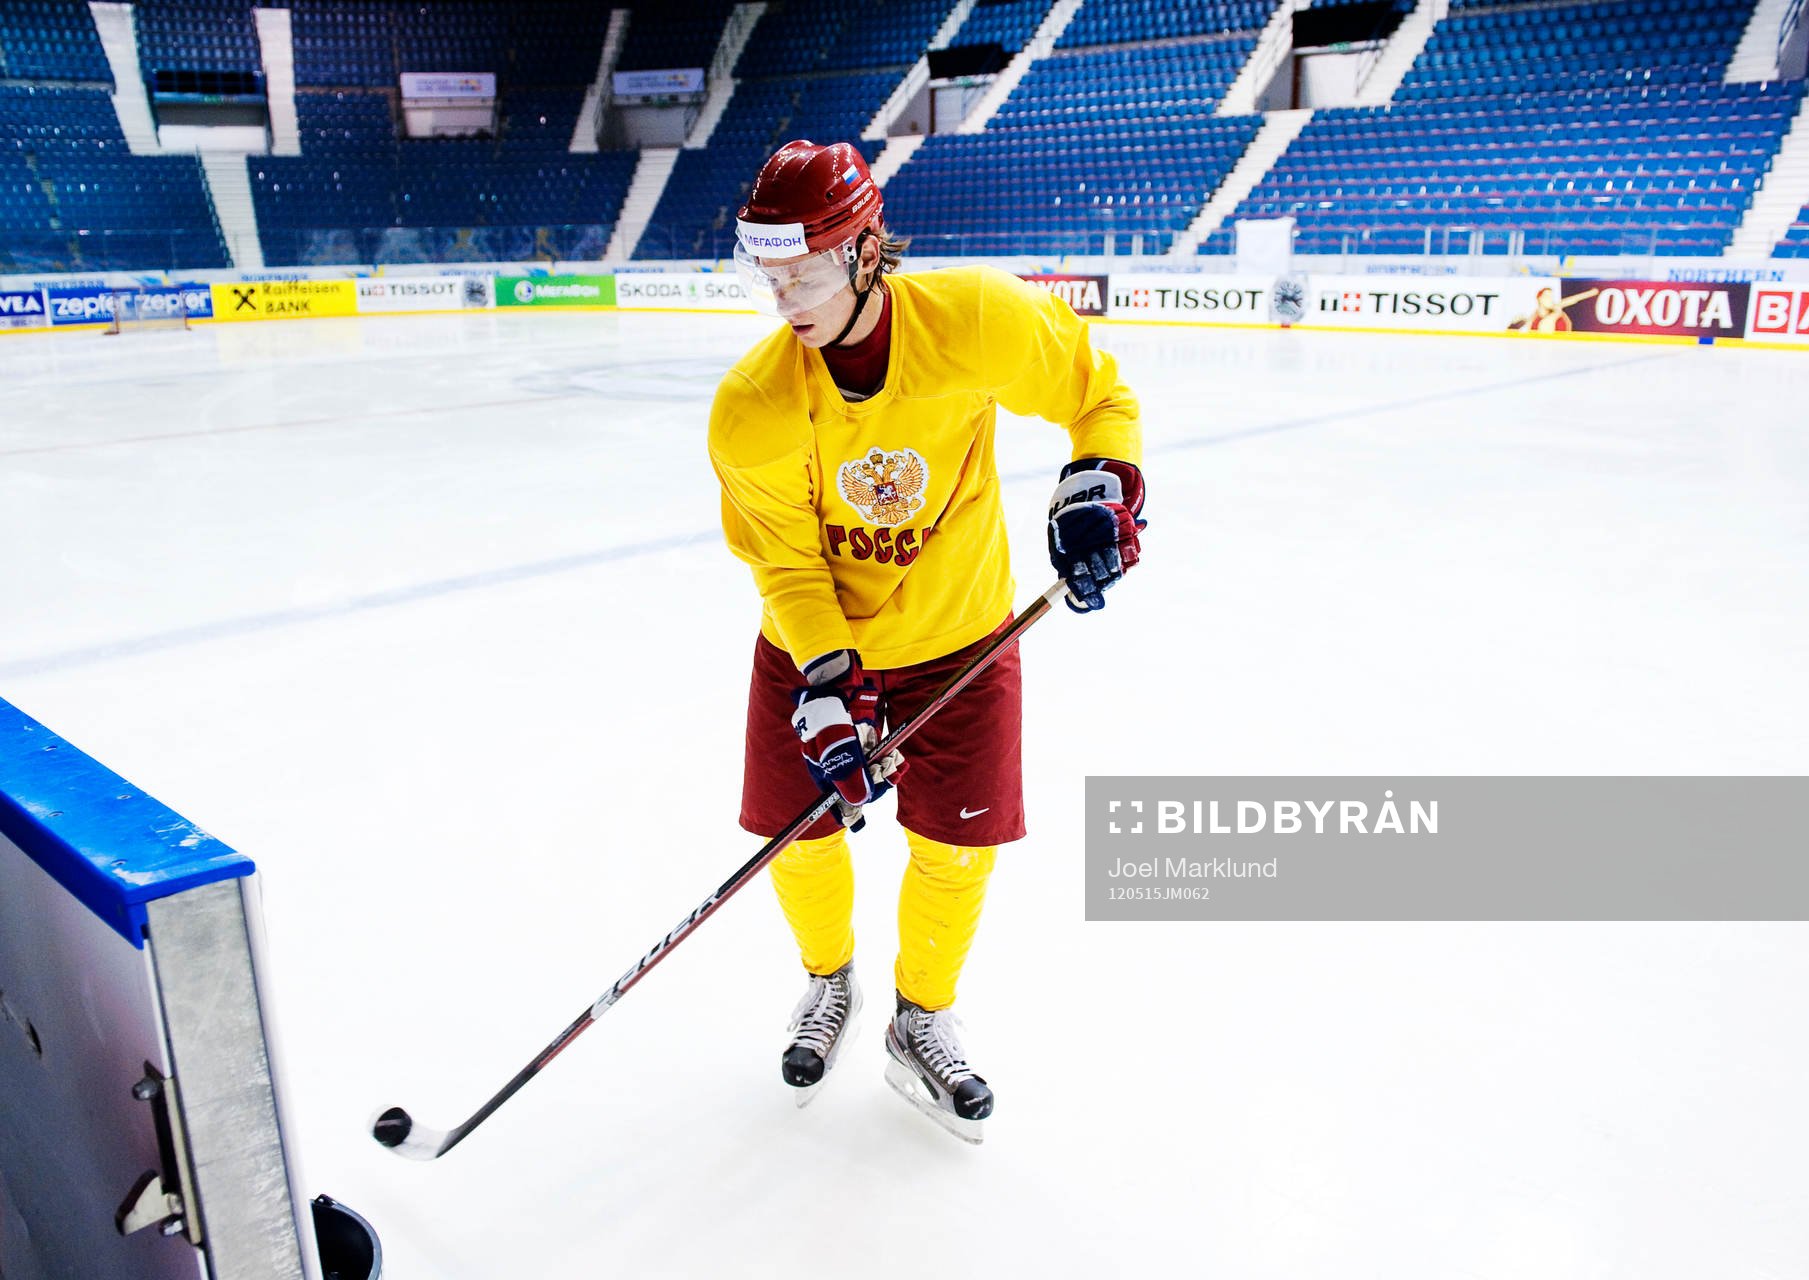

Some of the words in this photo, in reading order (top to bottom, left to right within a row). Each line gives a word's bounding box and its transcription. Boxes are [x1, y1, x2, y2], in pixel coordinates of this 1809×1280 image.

[852, 189, 874, 214] BAUER
[262, 279, 340, 296] Raiffeisen
[389, 282, 456, 297] TISSOT
[619, 282, 682, 298] ŠKODA
[265, 300, 311, 313] BANK
[1155, 289, 1264, 311] TISSOT
[1368, 293, 1499, 316] TISSOT
